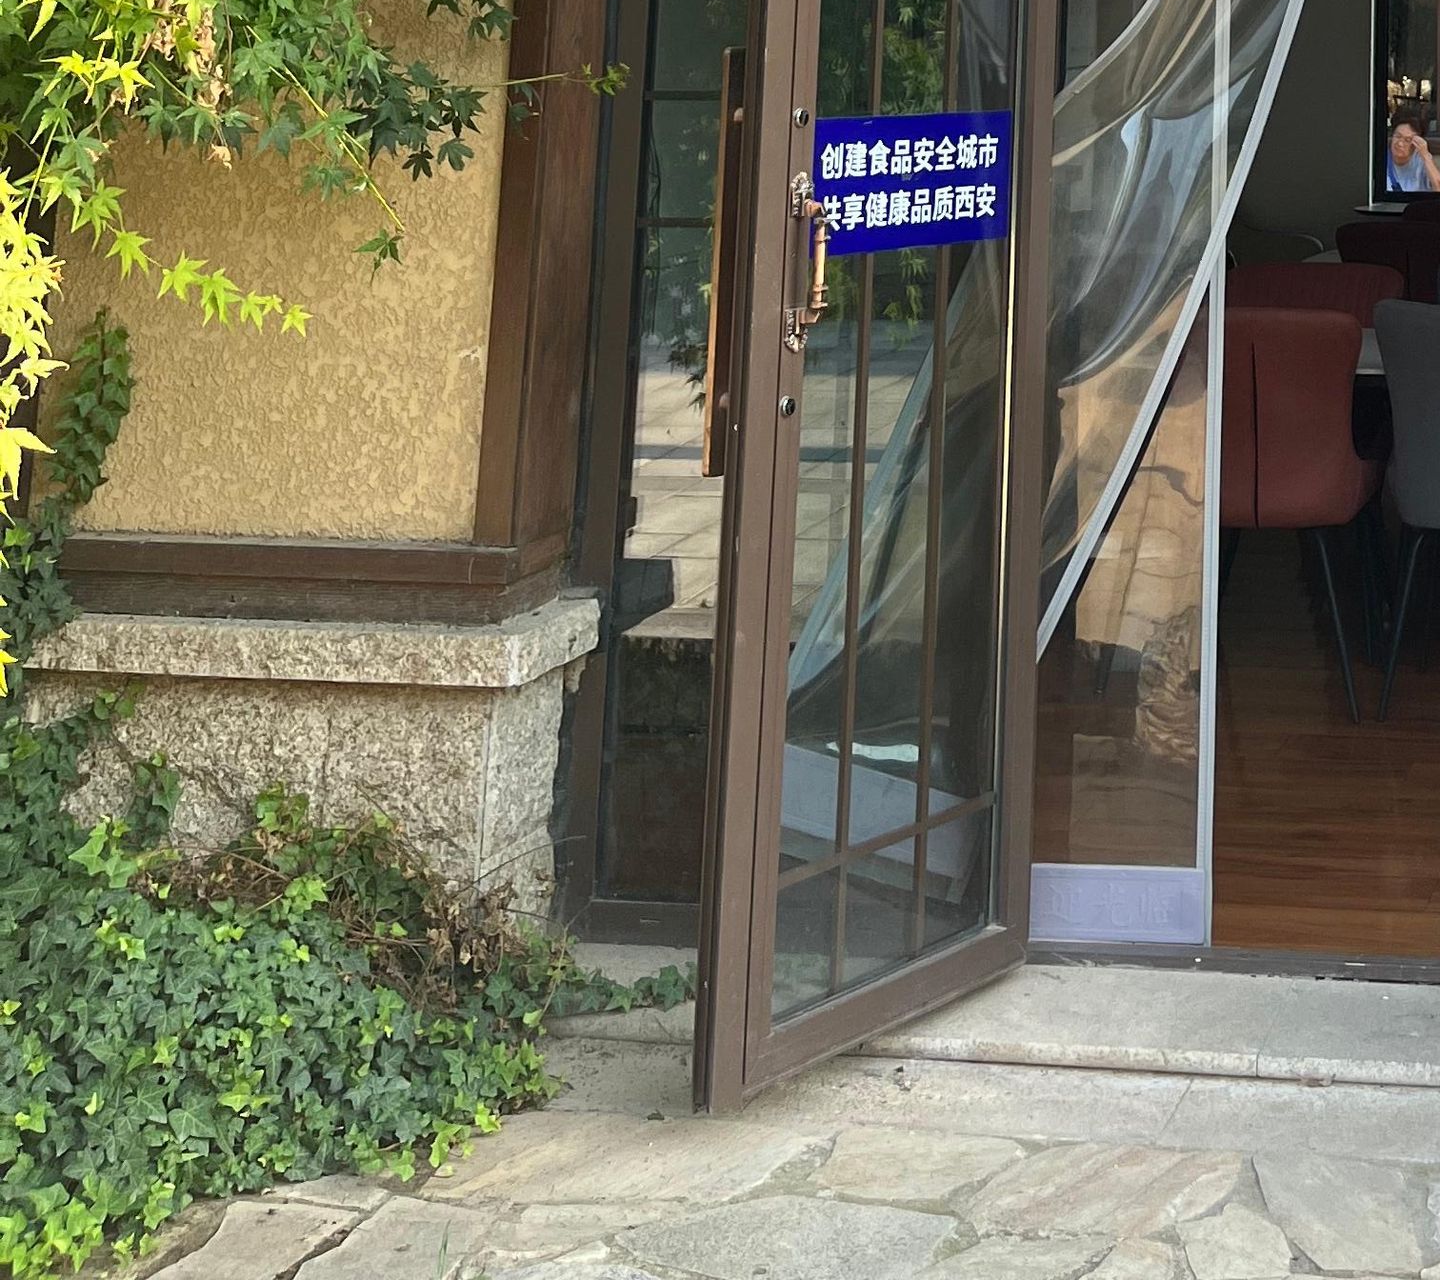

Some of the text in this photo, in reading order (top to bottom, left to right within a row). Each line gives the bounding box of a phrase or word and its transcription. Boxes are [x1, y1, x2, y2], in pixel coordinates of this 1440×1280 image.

[821, 133, 999, 180] 创建食品安全城市
[823, 183, 997, 232] 共享健康品质西安
